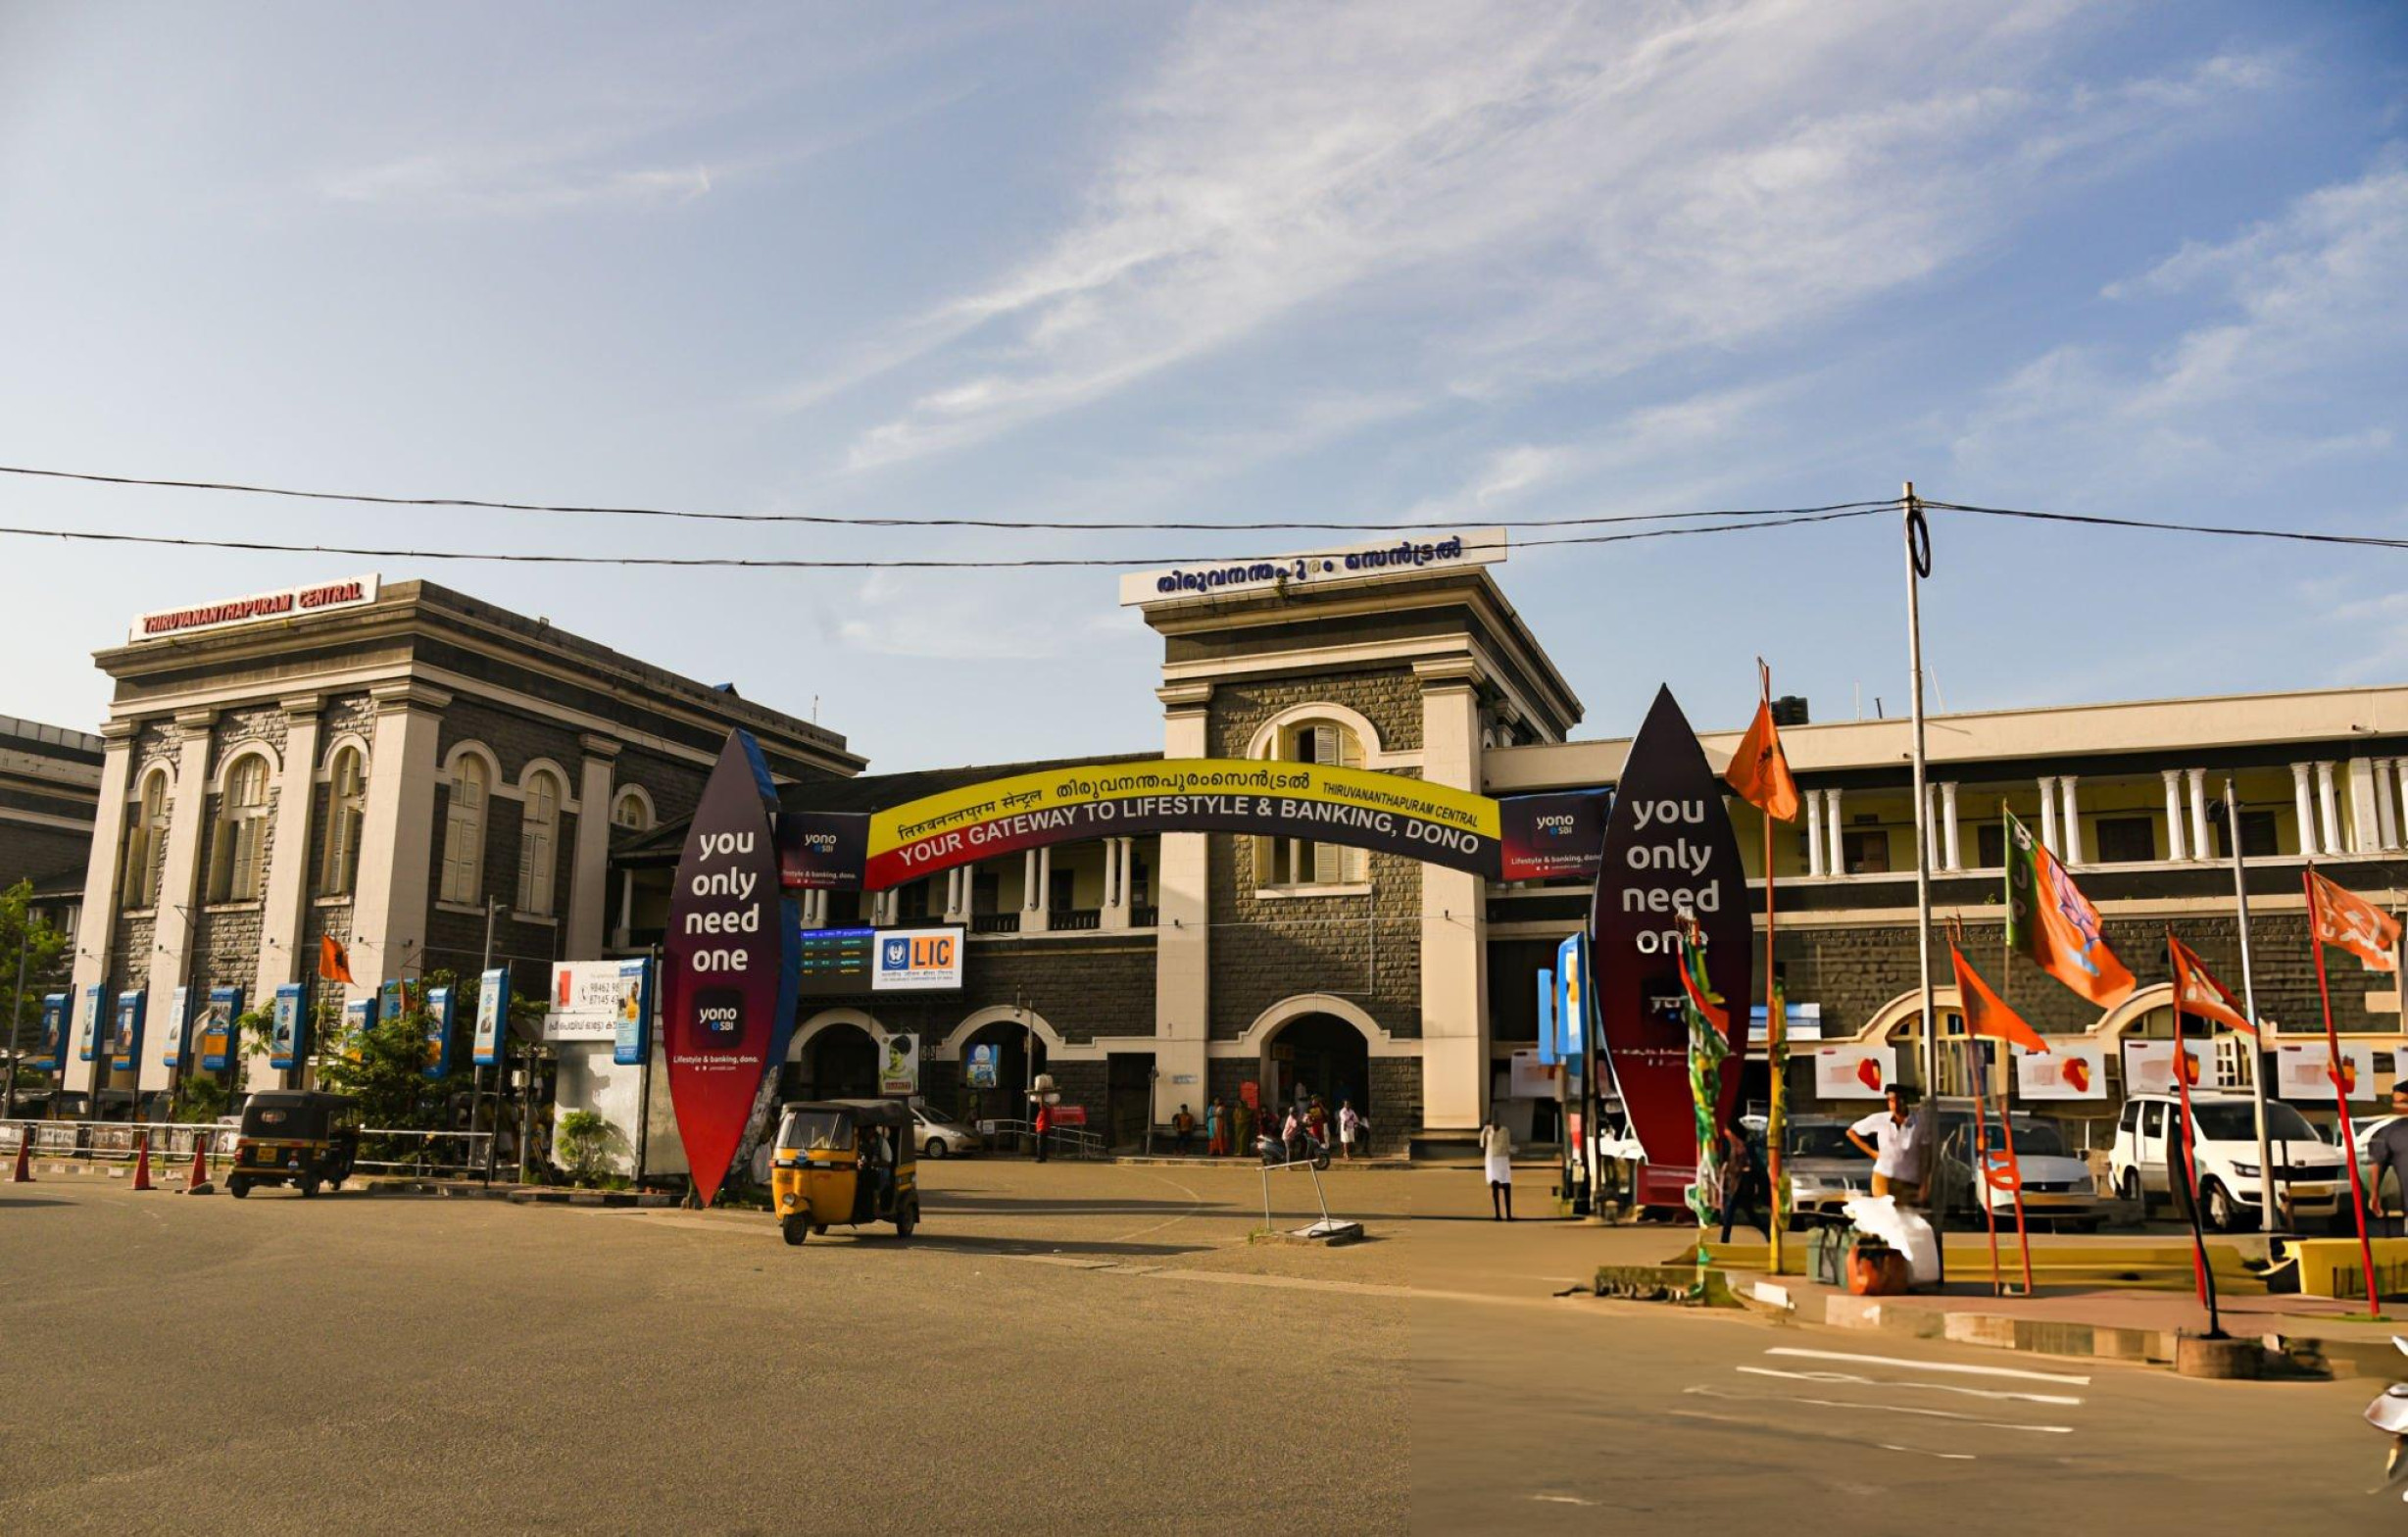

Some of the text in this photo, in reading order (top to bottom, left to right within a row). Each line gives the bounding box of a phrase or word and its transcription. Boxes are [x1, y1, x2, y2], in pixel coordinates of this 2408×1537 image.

[143, 582, 364, 633] THIRUVANANTHAPURAM CENTRAL
[1323, 782, 1478, 827] THIRUVANANTHAPURAM CENTRAL
[1632, 800, 1704, 831] you
[899, 796, 1479, 867] YOUR GATEWAY TO LIFESTYLE & BANKING, DONO
[1536, 815, 1574, 830] yono
[699, 832, 755, 862] you
[804, 834, 837, 847] yono
[1626, 837, 1712, 876] only
[692, 866, 757, 901] only
[1623, 879, 1720, 913] need
[686, 903, 760, 934] need
[692, 948, 749, 972] one
[914, 939, 950, 967] LIC
[699, 1007, 737, 1023] yono
[719, 1021, 734, 1031] SBI
[673, 1055, 702, 1065] Lifestyle
[703, 1055, 709, 1064] &
[710, 1055, 739, 1066] banking,
